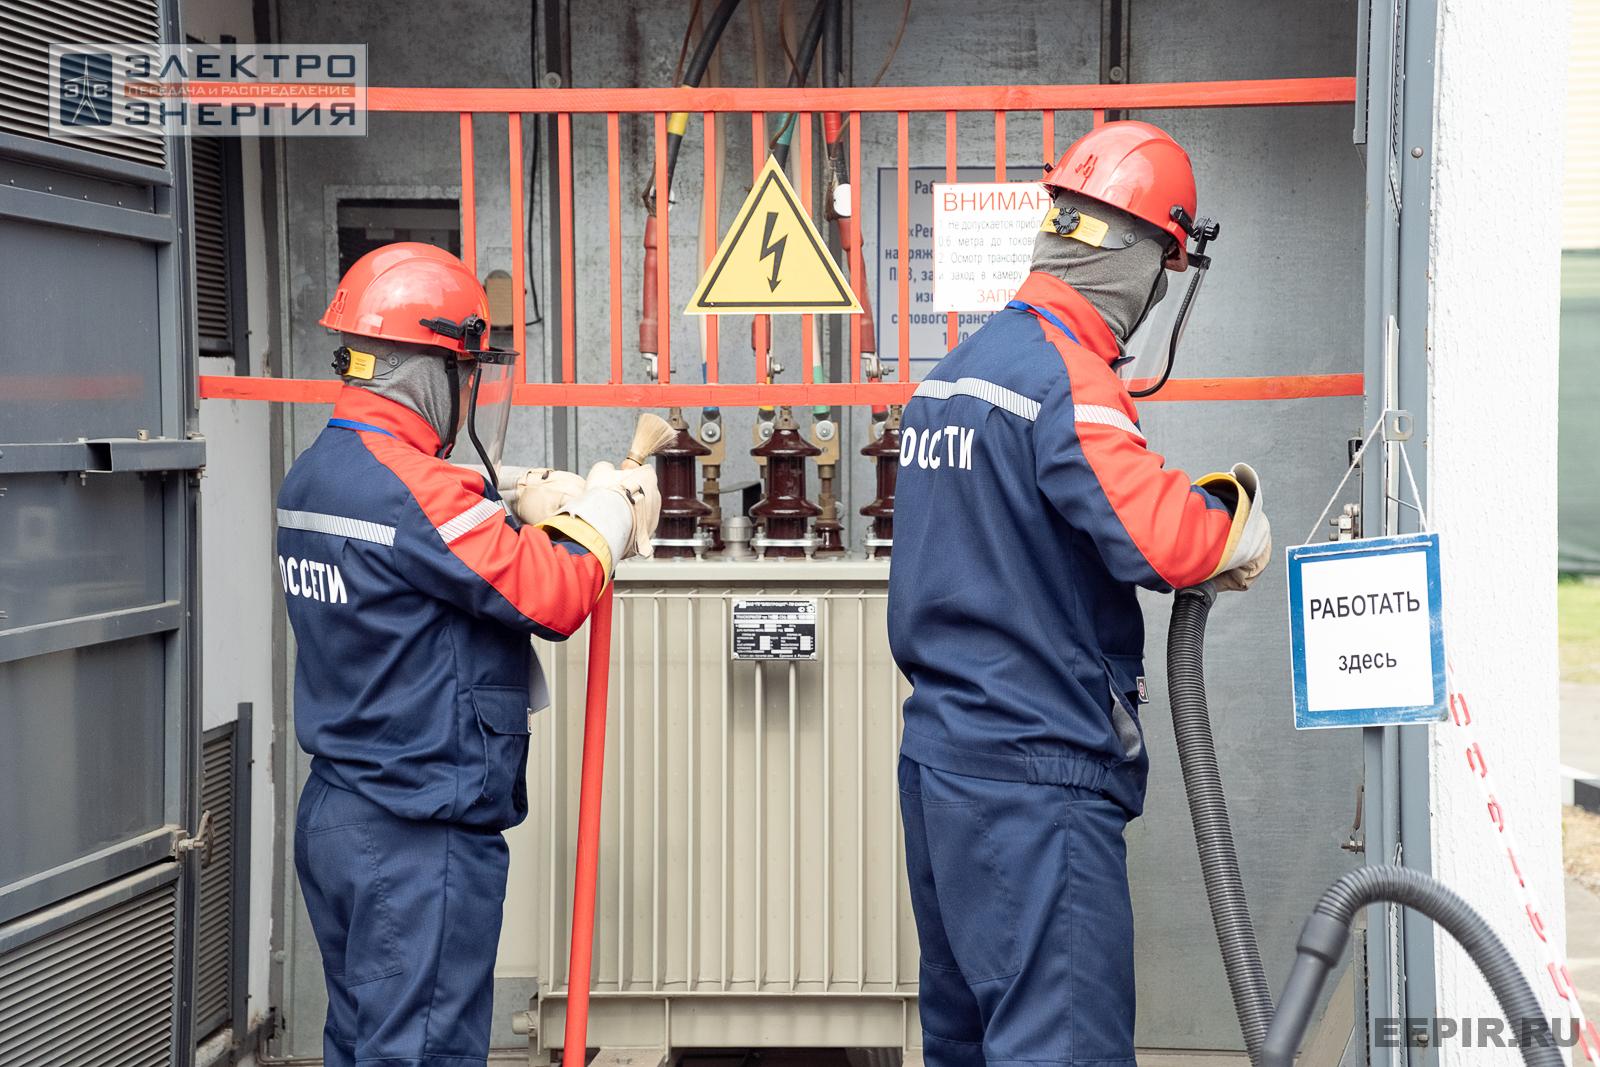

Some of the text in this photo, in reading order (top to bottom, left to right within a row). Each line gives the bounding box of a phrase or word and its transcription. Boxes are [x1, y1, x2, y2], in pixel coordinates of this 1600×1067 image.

[943, 191, 1051, 212] ВНИМАН
[961, 220, 1013, 232] допускается
[958, 237, 984, 248] метра
[991, 237, 1002, 247] до
[885, 248, 933, 262] наряж
[951, 252, 983, 265] Осмотр
[952, 271, 975, 281] заход
[992, 271, 1022, 282] камеру
[891, 313, 948, 325] слового
[1310, 590, 1420, 620] РАБОТАТЬ
[1338, 652, 1397, 674] здесь
